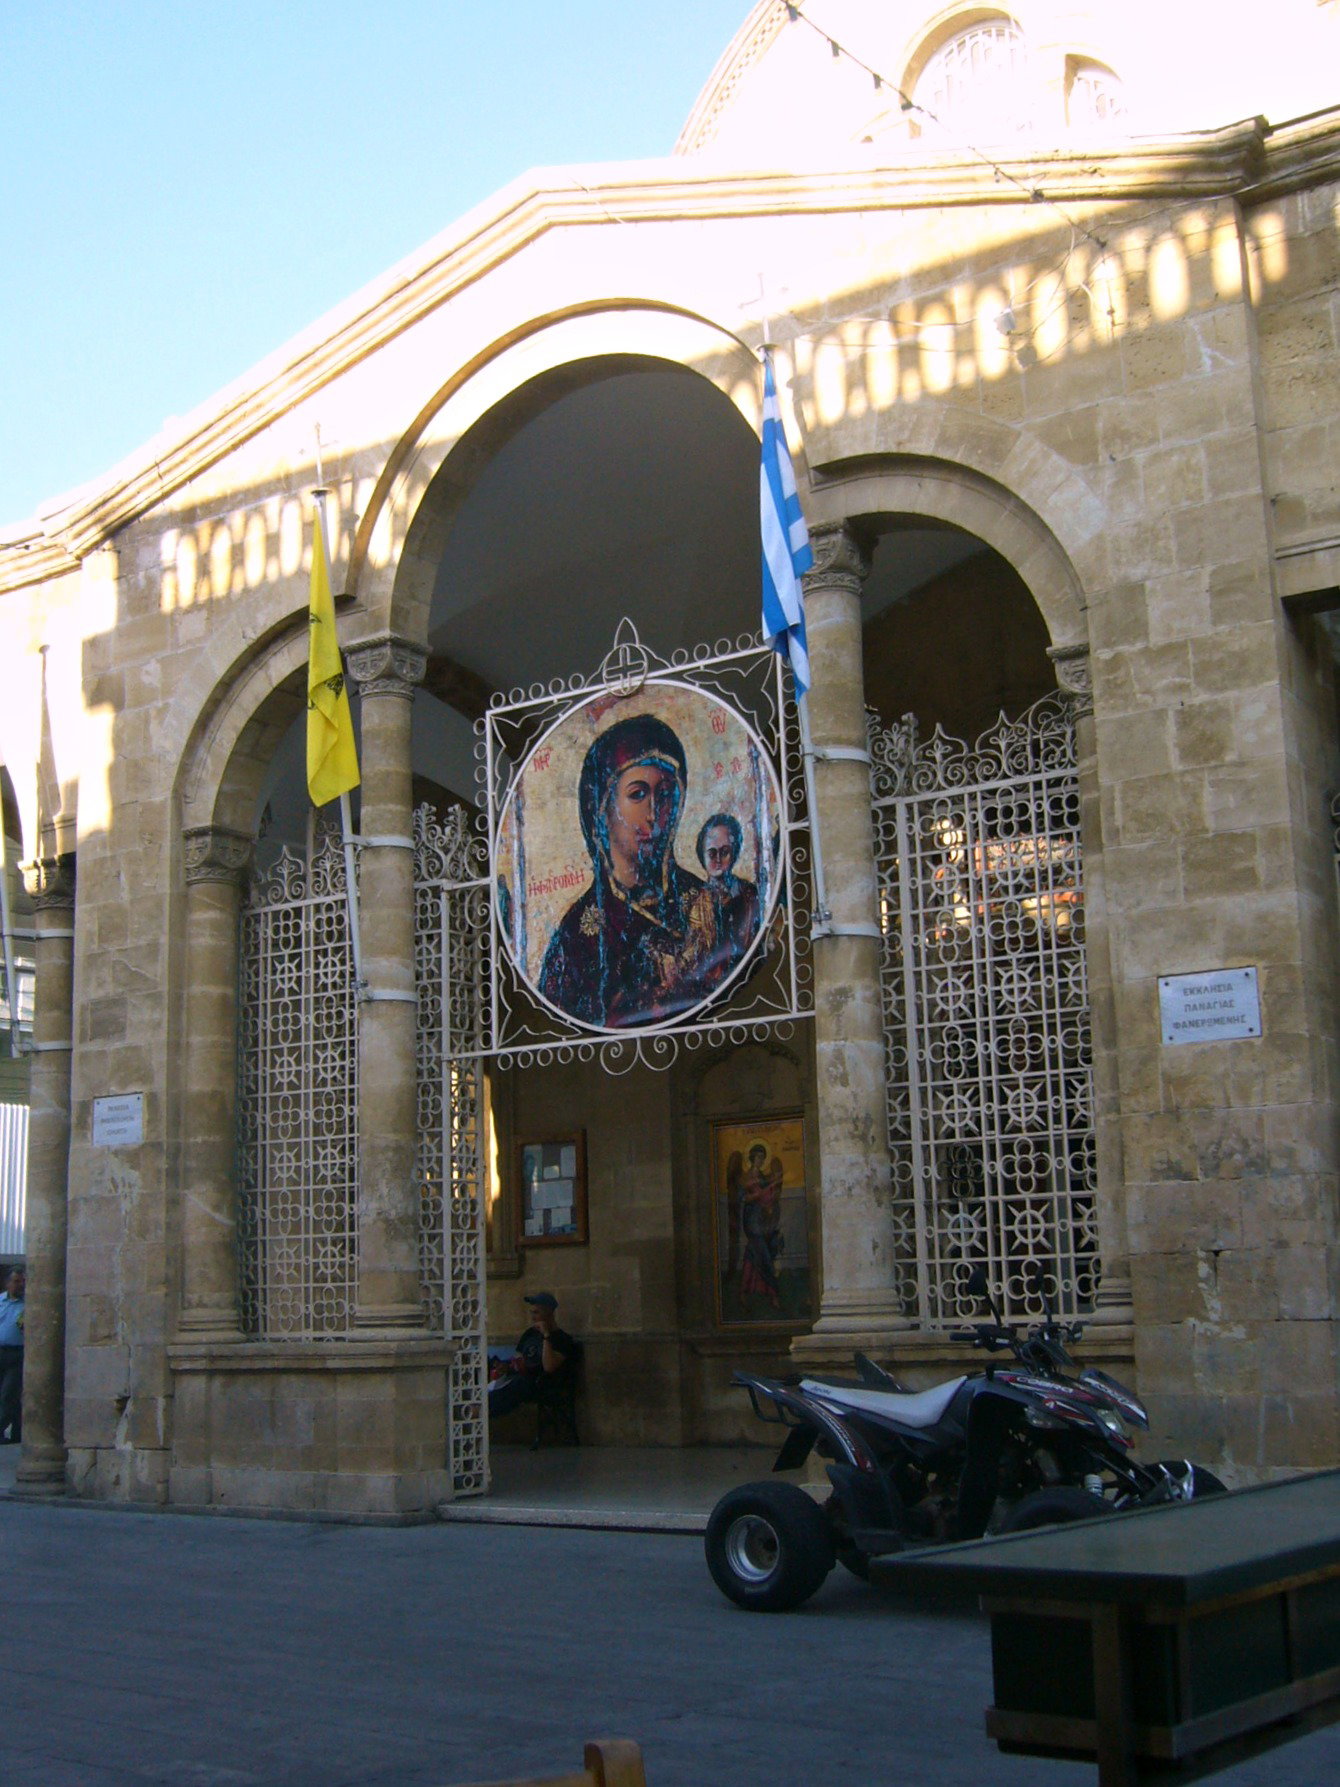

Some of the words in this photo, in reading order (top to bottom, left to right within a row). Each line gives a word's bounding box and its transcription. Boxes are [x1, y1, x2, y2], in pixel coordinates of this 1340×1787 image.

[1183, 983, 1234, 996] ΕΚΚΛΗΣΙΑ
[1184, 999, 1235, 1012] ΠΑΝΑΓΙΑΣ
[1172, 1014, 1247, 1030] ΦΑΝΕΡΩΜΕΝΗΣ
